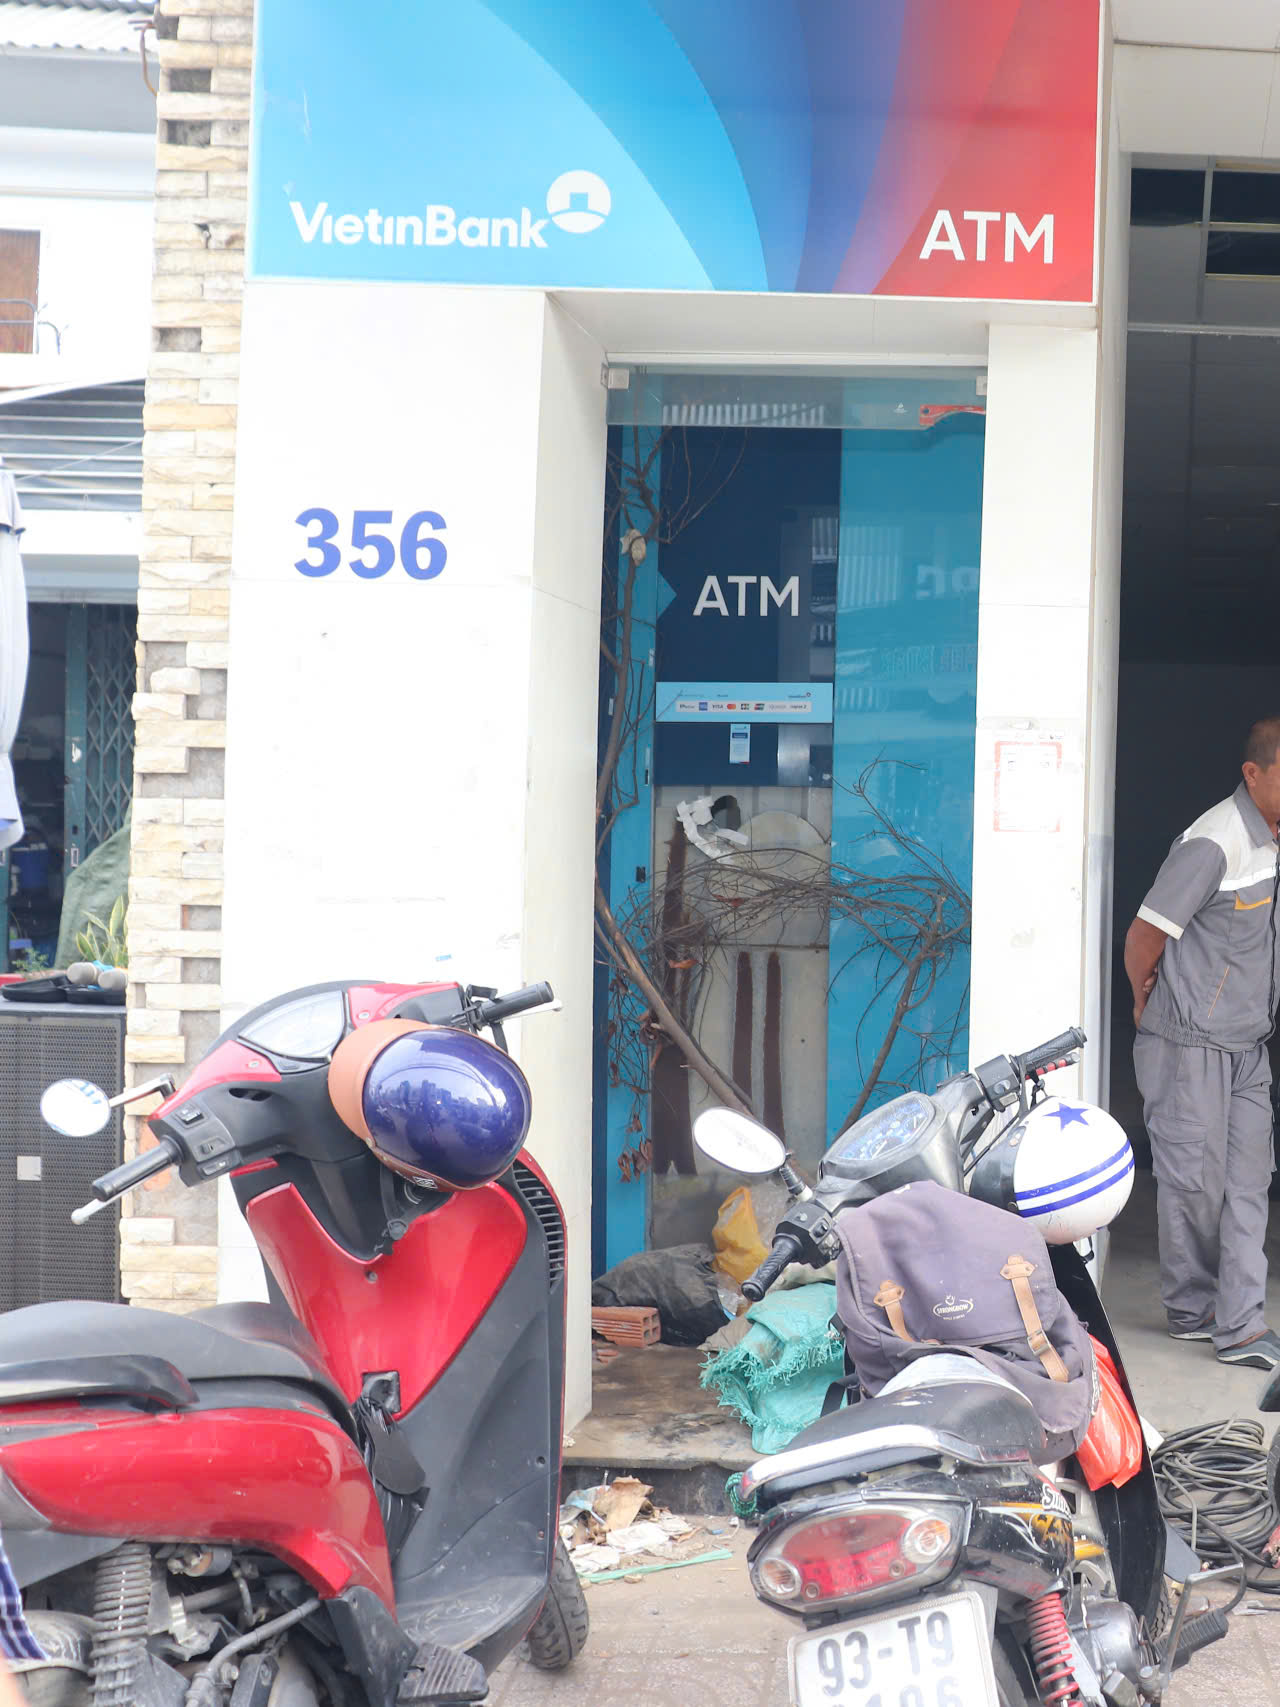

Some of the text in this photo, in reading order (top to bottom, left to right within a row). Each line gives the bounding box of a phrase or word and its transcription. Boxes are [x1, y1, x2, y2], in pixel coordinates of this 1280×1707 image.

[289, 201, 550, 248] VietinBank
[919, 209, 1055, 264] ATM
[294, 507, 448, 580] 356
[692, 575, 800, 617] ATM
[817, 1610, 954, 1697] 93-T9
